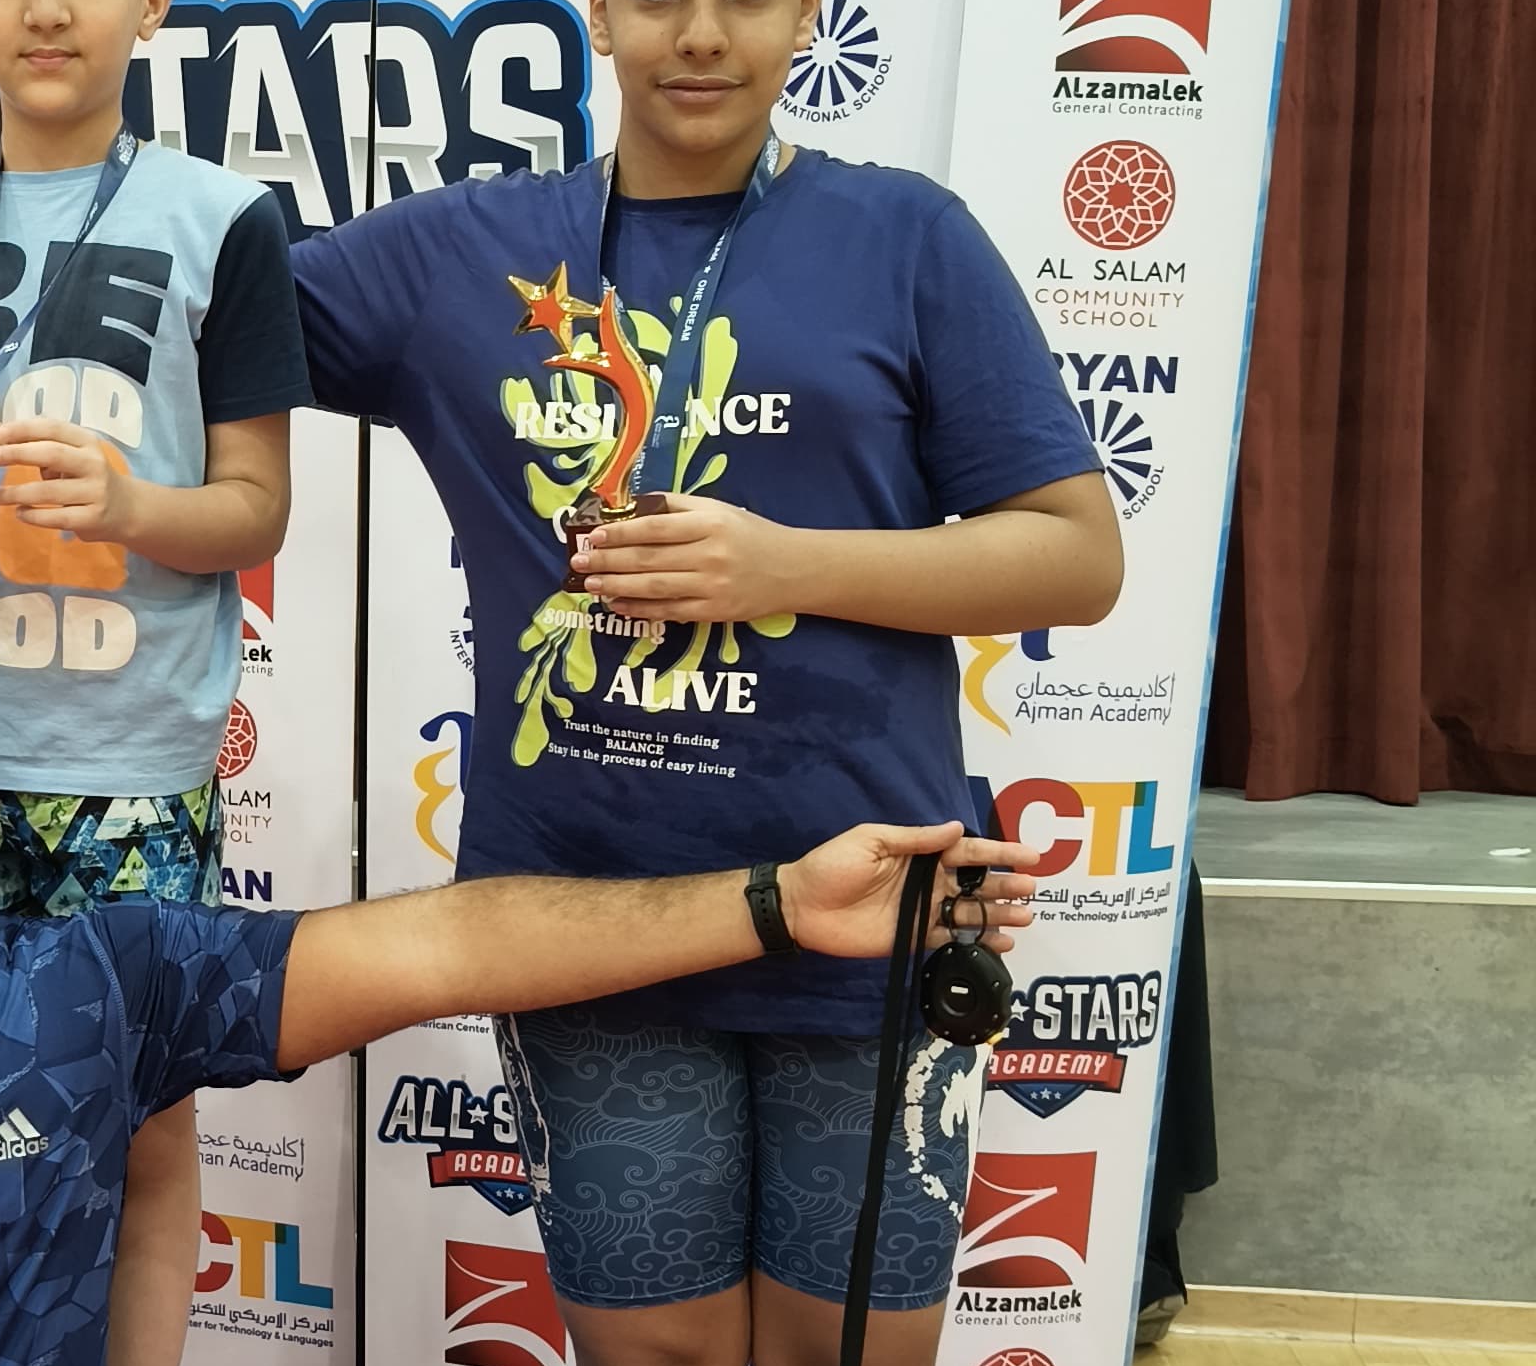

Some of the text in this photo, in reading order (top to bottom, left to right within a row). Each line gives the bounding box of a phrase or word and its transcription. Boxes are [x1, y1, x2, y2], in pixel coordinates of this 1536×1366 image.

[853, 53, 893, 110] SCHOOL
[1052, 77, 1203, 103] Alzamalek
[1052, 101, 1203, 120] General Contracting
[1036, 257, 1186, 284] AL SALAM
[691, 279, 708, 306] ONE
[1034, 288, 1186, 309] COMMUNITY
[680, 306, 700, 343] DREAM
[1058, 309, 1158, 328] SCHOOL
[1121, 465, 1165, 521] SCHOOL
[544, 608, 666, 645] something
[604, 665, 758, 714] ALIVE
[1015, 671, 1093, 700] عجمان
[1015, 700, 1173, 726] Ajman Academy
[564, 719, 720, 750] Trust the nature in finding
[605, 738, 664, 756] BALANCE
[548, 741, 736, 778] Stay in the process of easy living
[1040, 911, 1056, 922] for
[1059, 911, 1120, 923] Technology
[1120, 909, 1128, 920] &
[1033, 979, 1161, 1045] STARS
[455, 1022, 490, 1034] Center
[987, 1051, 1108, 1076] ACADEMY
[384, 1082, 474, 1142] ALL
[229, 1153, 305, 1182] Academy
[955, 1289, 1083, 1313] Alzamalek
[954, 1312, 1083, 1326] General Contracting
[204, 1320, 334, 1348] for Technology & Languages
